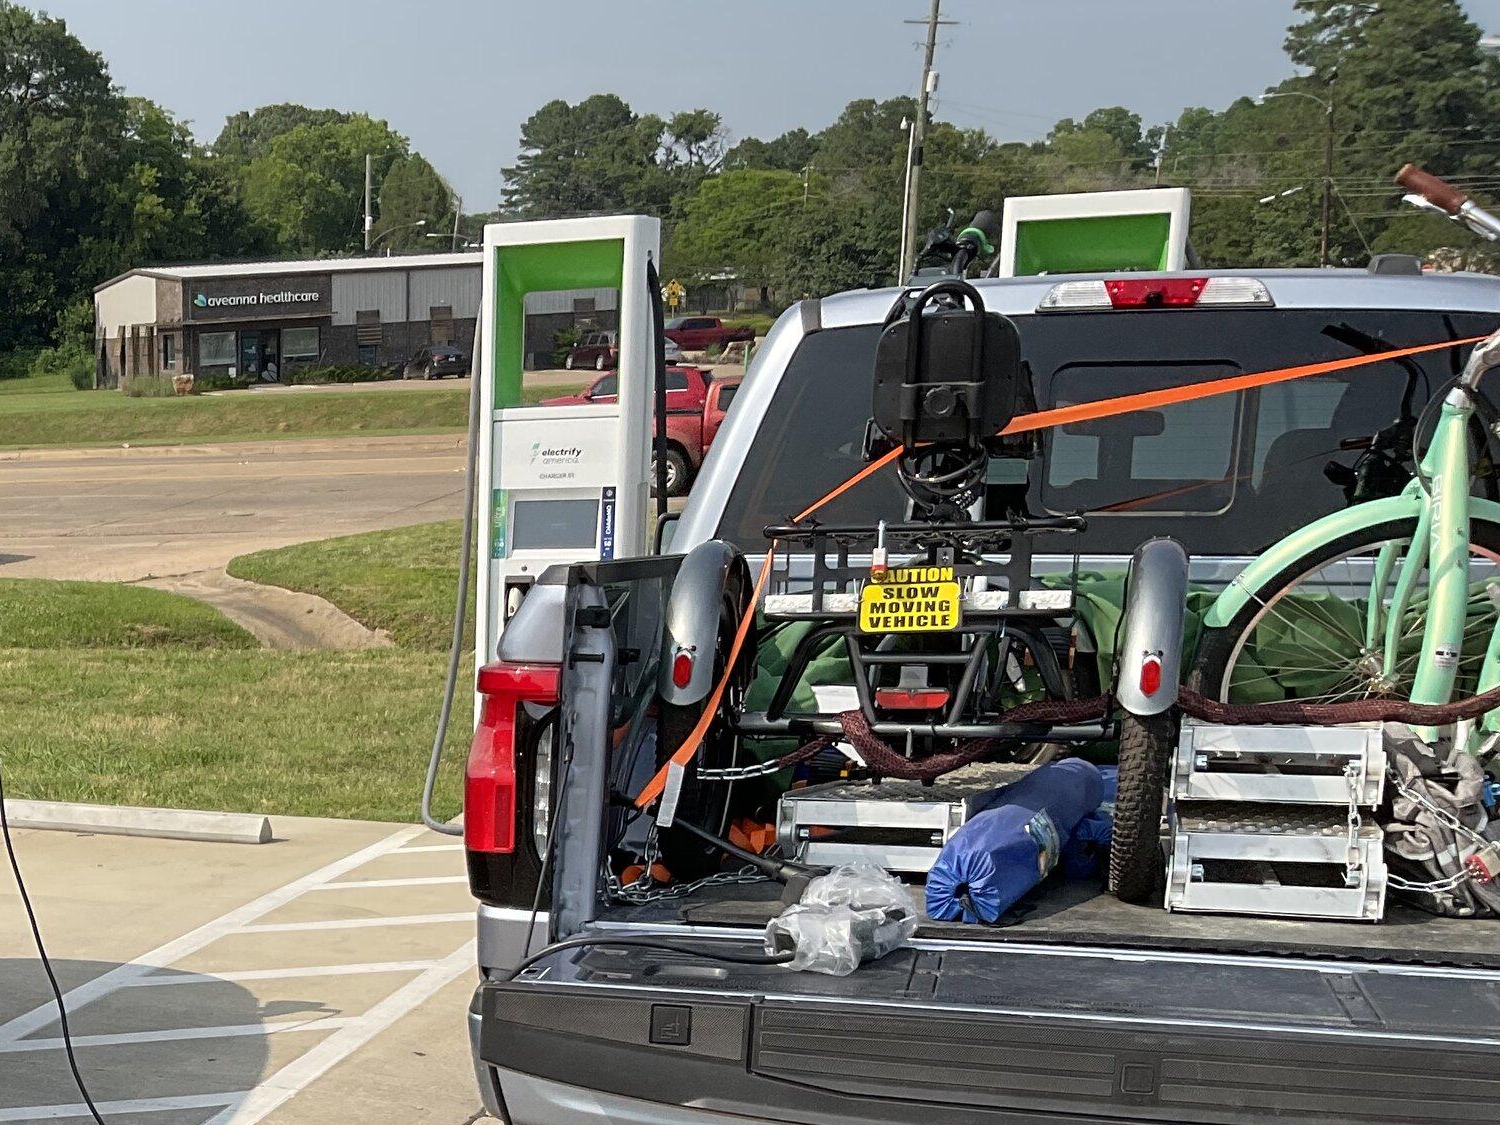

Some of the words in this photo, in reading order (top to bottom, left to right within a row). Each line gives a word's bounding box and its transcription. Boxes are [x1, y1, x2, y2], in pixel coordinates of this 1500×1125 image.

[207, 296, 257, 307] aveanna
[259, 291, 319, 304] healthcare
[542, 448, 582, 457] electrify
[883, 586, 940, 599] SLOW
[869, 600, 951, 614] MOVING
[869, 614, 951, 628] VEHICLE
